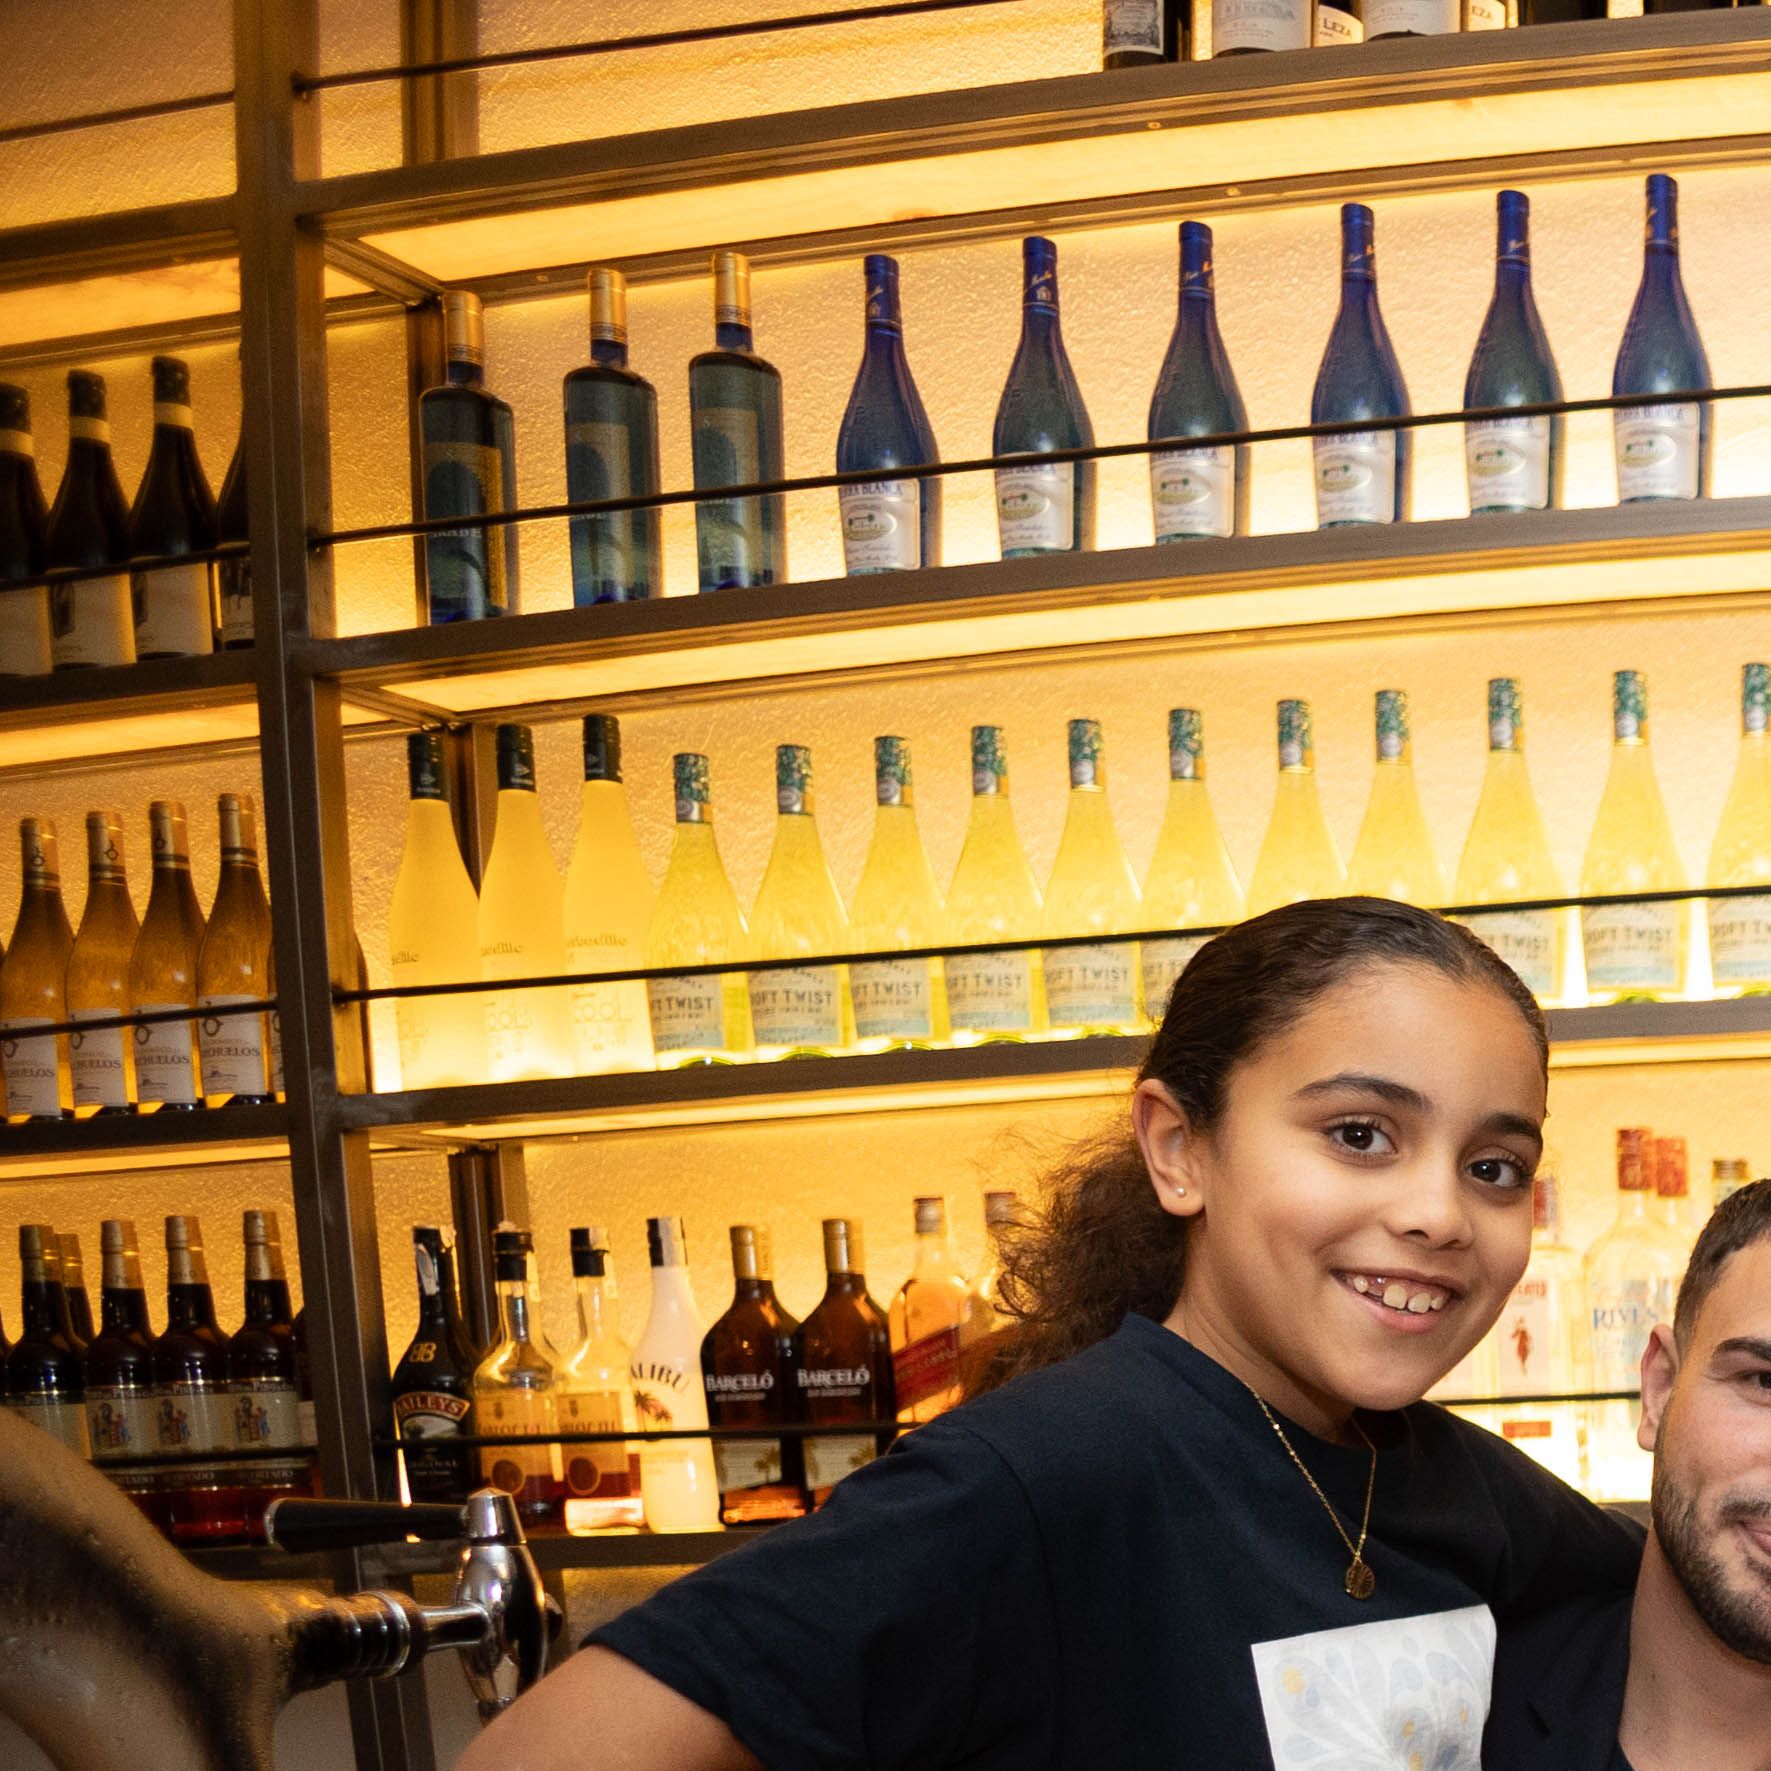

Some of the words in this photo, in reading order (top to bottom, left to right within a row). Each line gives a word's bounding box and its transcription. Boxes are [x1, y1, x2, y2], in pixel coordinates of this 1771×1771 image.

[706, 1369, 774, 1391] BARCELÓ
[797, 1364, 871, 1387] BARCELÓ
[401, 1397, 463, 1415] AILEYS
